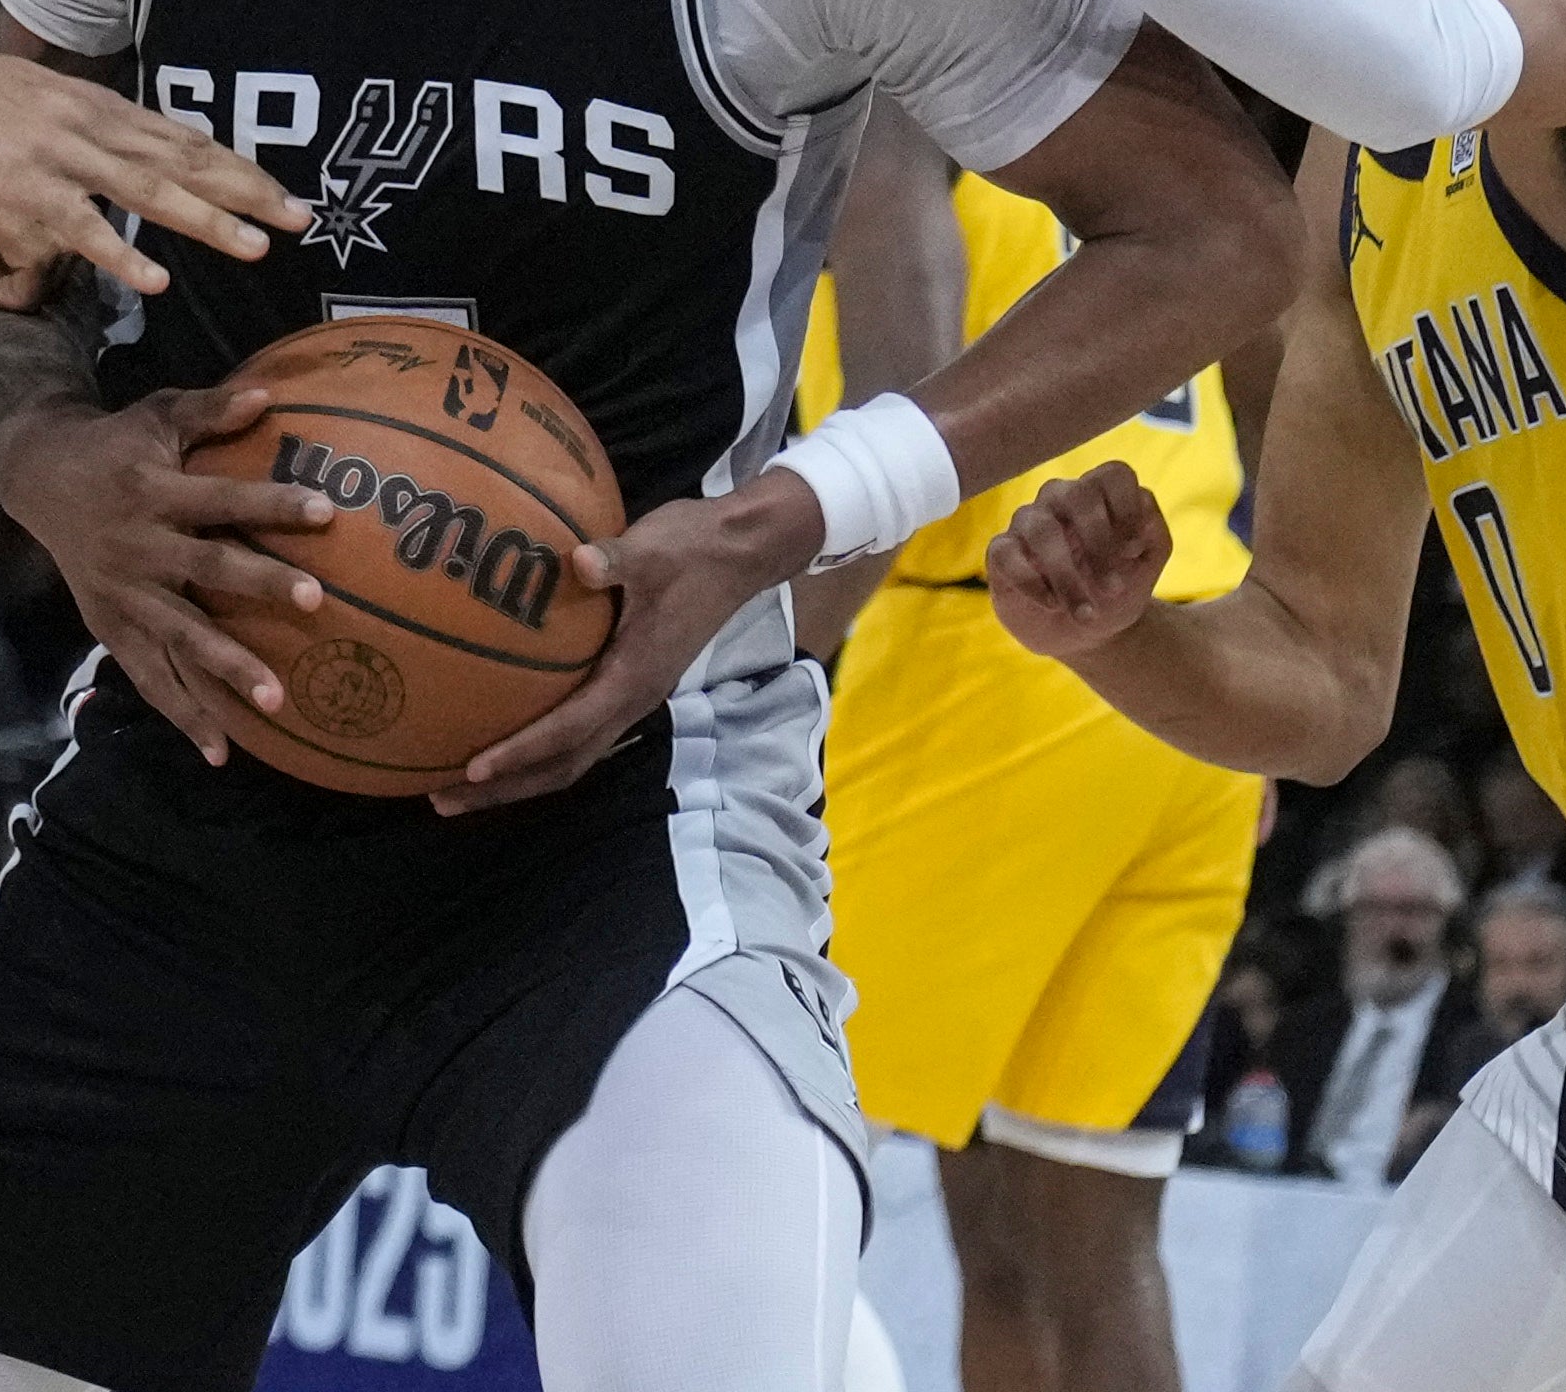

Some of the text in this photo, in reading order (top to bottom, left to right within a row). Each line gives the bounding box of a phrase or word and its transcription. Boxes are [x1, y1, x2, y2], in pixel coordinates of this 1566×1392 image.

[271, 433, 561, 633] Wilson
[1450, 483, 1556, 699] 0
[270, 1163, 492, 1371] 025
